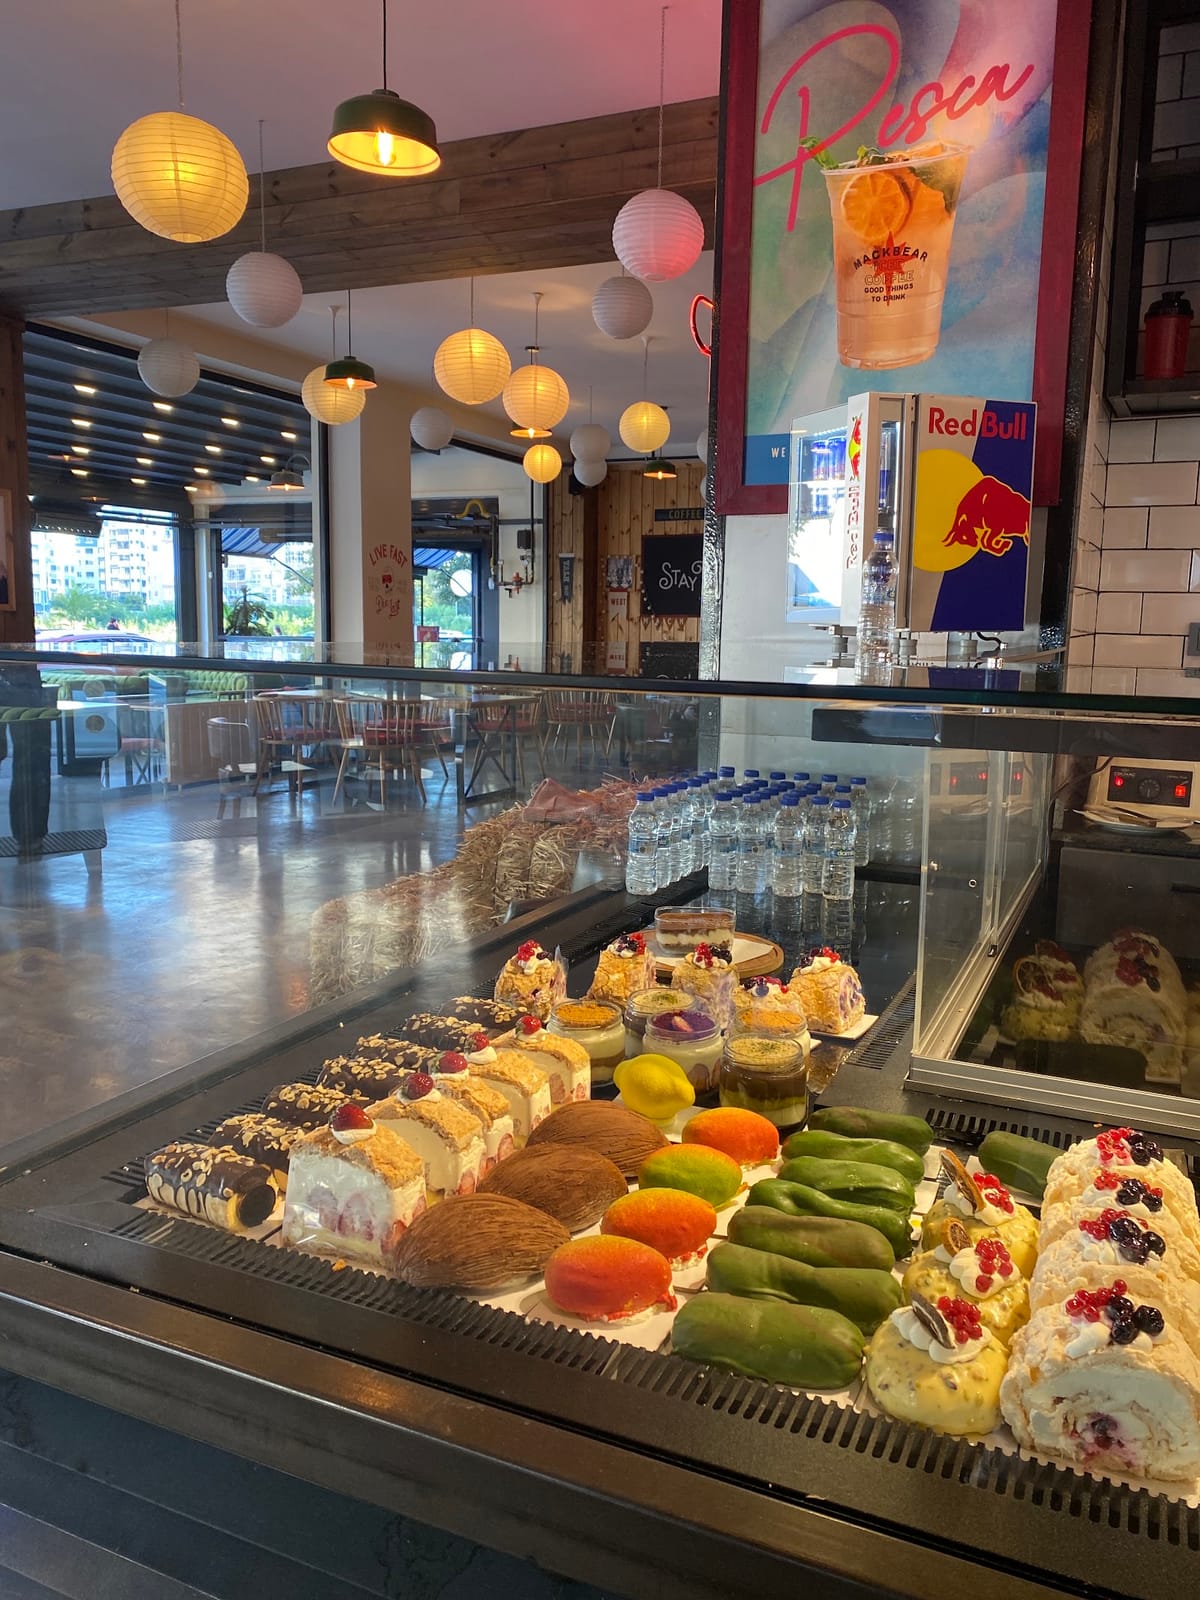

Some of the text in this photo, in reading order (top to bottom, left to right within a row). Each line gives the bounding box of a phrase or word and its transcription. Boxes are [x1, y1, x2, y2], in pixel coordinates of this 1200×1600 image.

[753, 23, 1035, 232] Pesca
[853, 246, 928, 270] MACKBEAR
[864, 282, 914, 294] GOOD THINGS
[883, 293, 906, 302] DRINK
[928, 407, 1028, 440] Red Bull
[771, 447, 786, 458] WE
[668, 509, 701, 519] COFFEE
[369, 544, 408, 568] LIVE FAST
